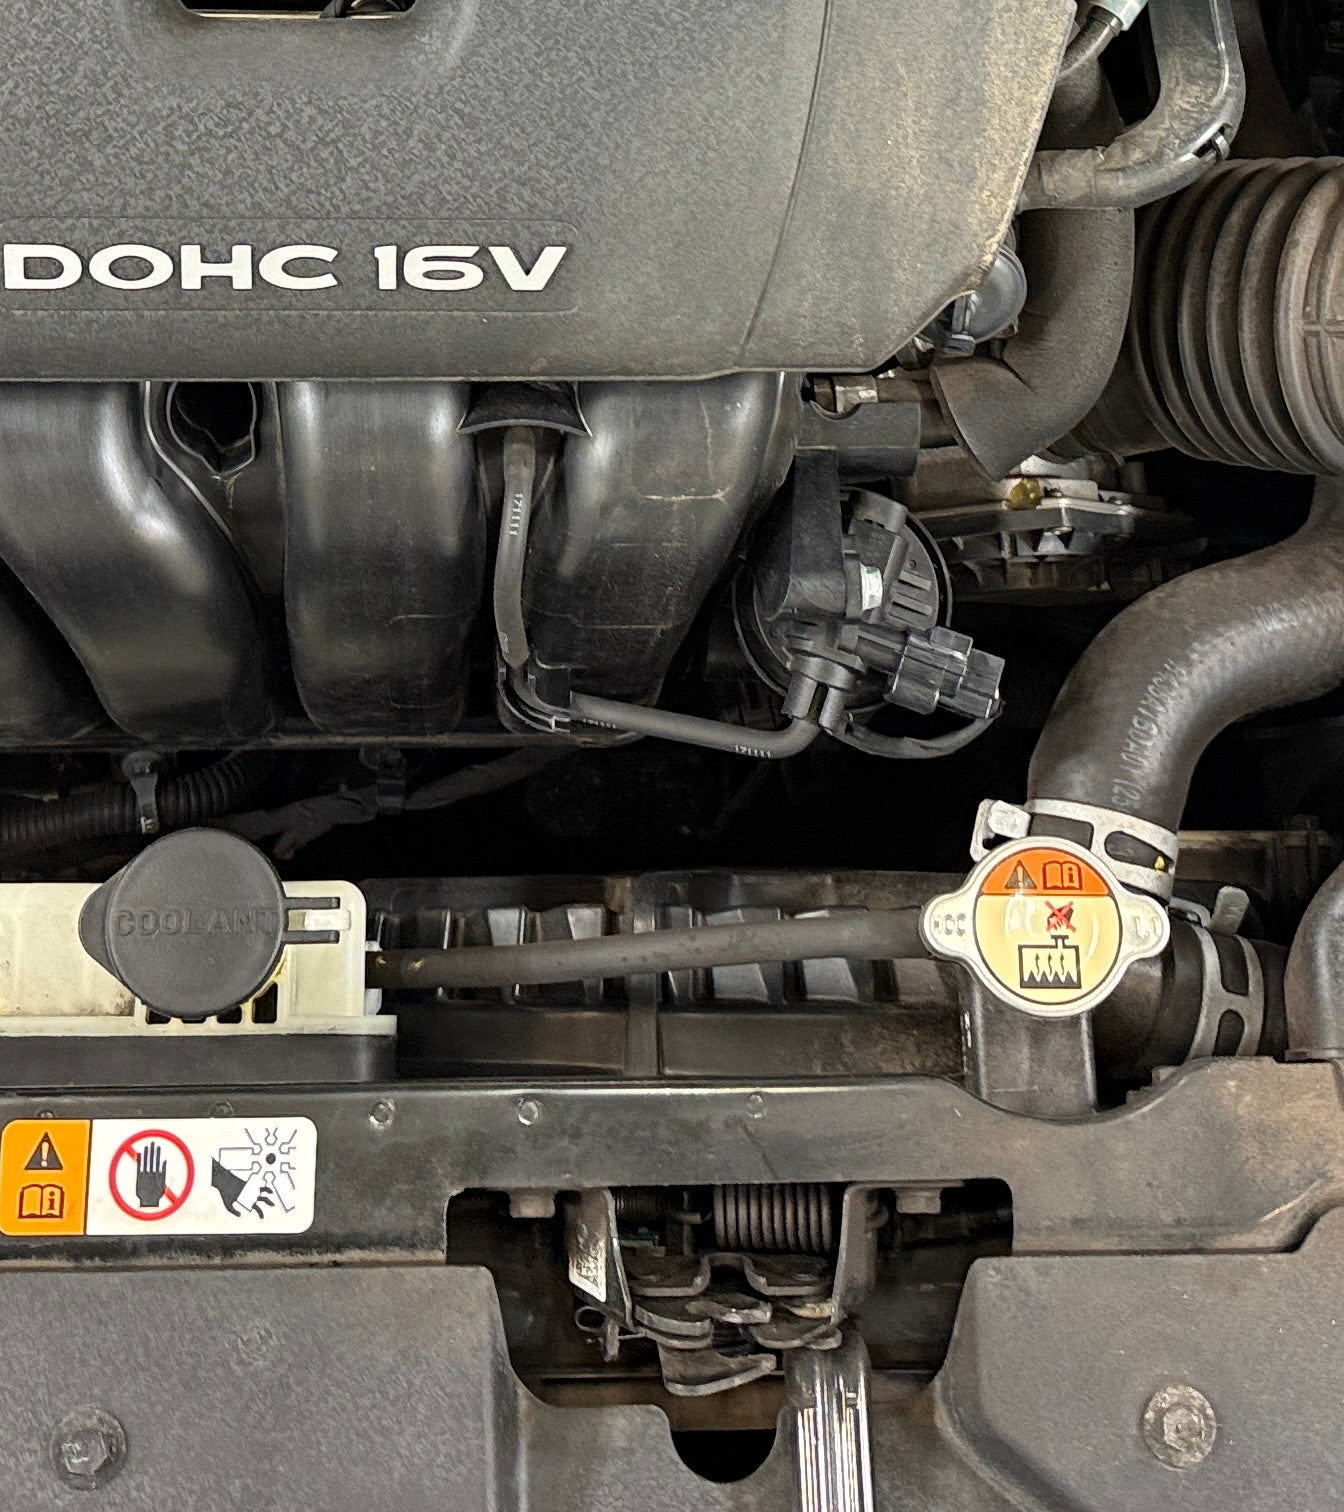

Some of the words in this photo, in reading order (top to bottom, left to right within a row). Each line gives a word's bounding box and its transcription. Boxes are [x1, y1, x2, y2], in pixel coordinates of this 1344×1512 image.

[2, 242, 340, 292] DOHC
[373, 243, 568, 292] 16V
[113, 904, 280, 937] COOLANT
